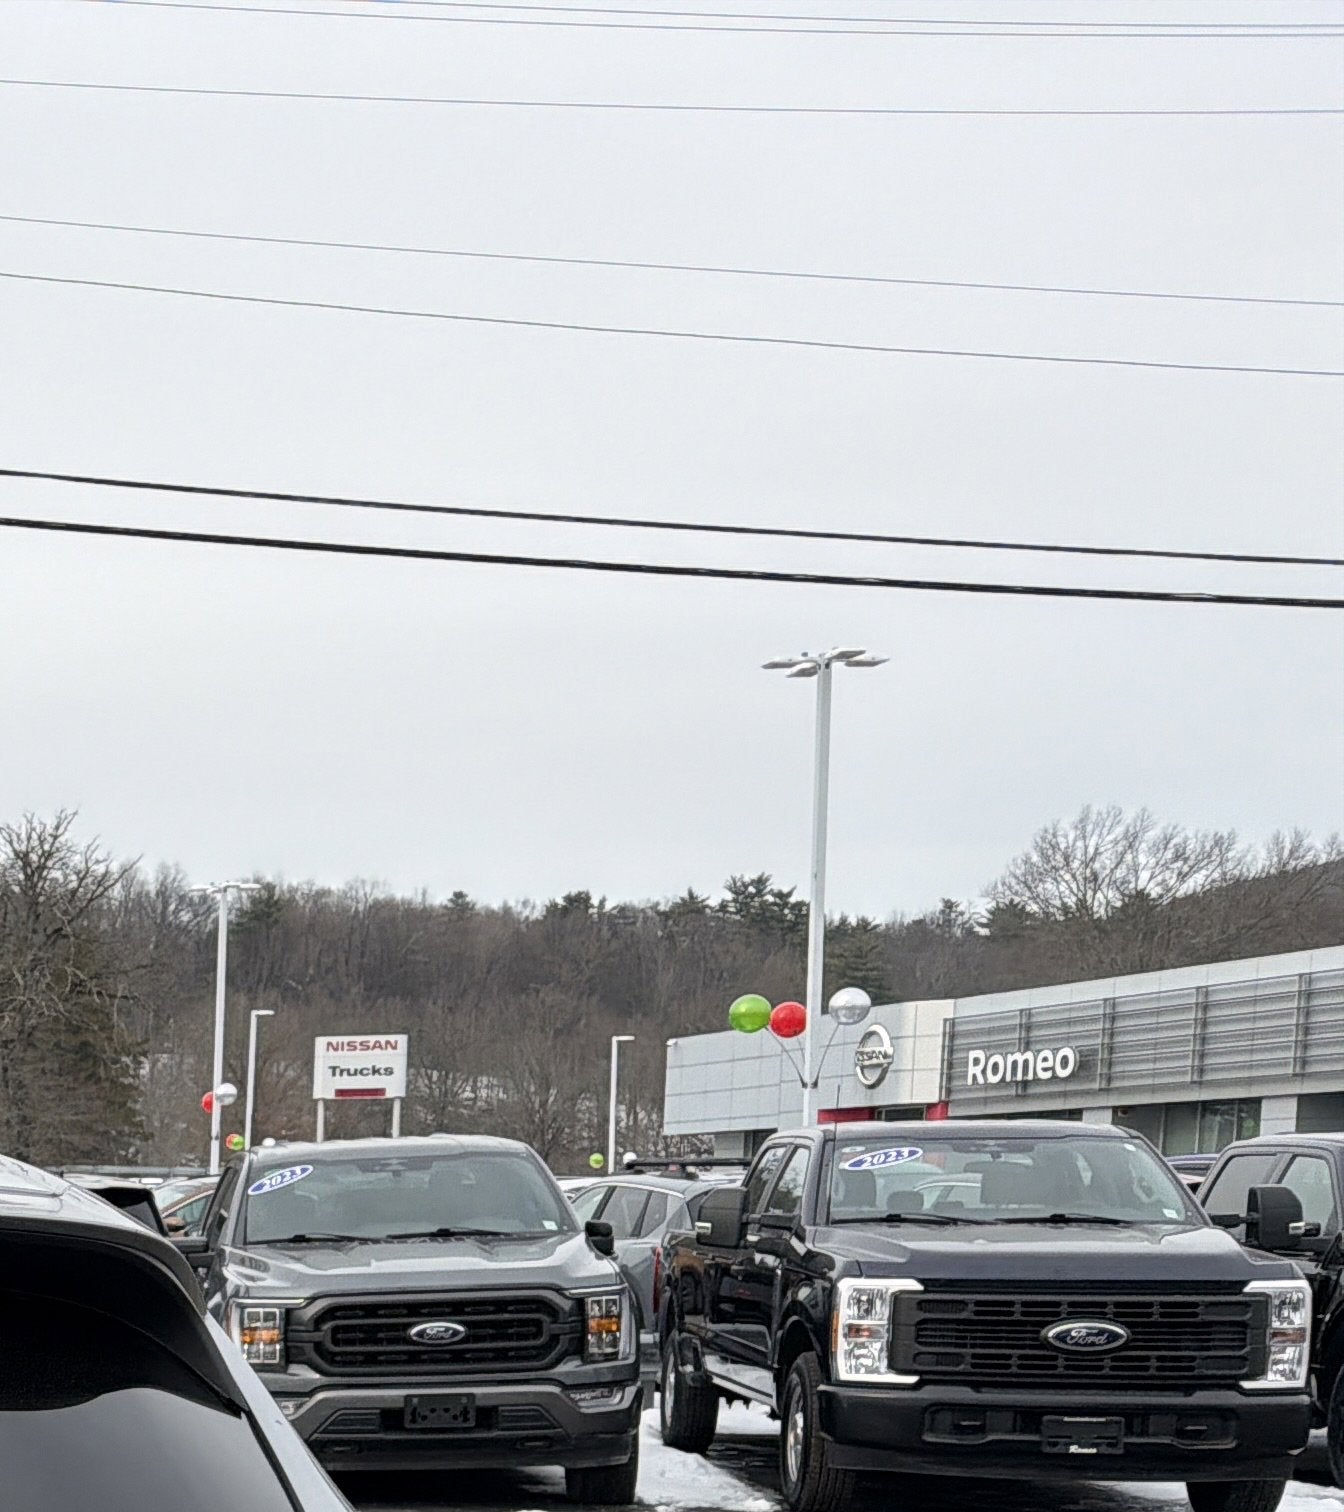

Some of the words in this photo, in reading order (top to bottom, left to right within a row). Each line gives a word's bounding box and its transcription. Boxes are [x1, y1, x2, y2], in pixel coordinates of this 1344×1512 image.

[326, 1040, 398, 1052] NISSAN
[328, 1065, 394, 1077] Trucks
[967, 1047, 1076, 1086] Romeo
[862, 1148, 909, 1167] 2023
[424, 1327, 453, 1340] Ford
[1067, 1329, 1110, 1344] Ford
